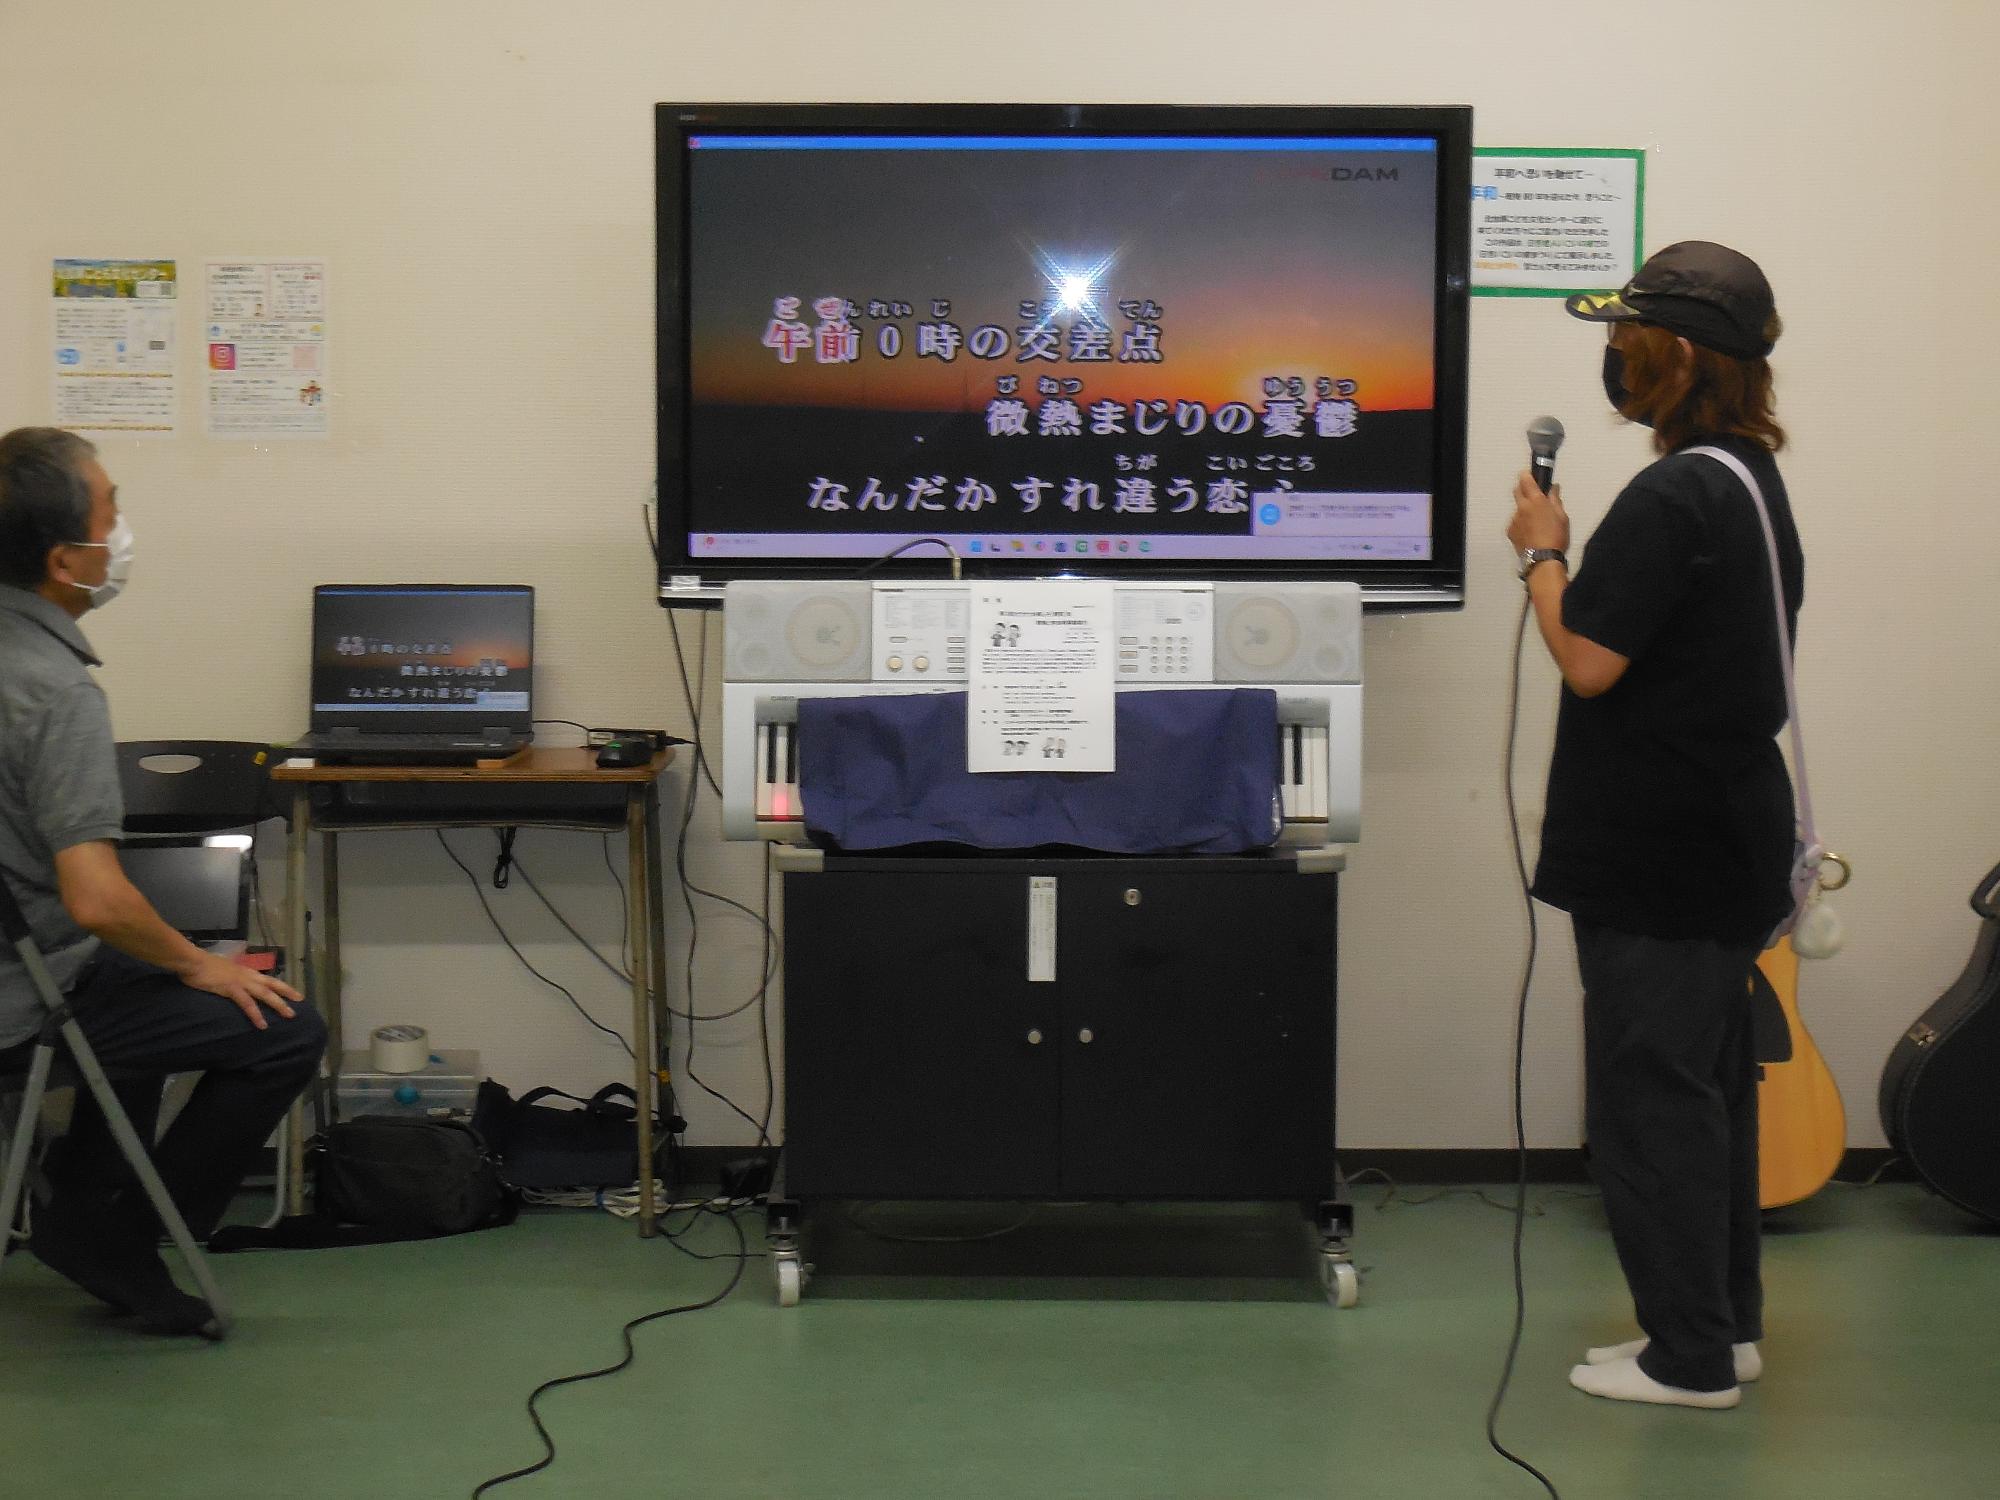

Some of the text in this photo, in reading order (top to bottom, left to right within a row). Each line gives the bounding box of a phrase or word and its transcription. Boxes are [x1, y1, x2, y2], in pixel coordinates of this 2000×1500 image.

[1331, 166, 1399, 182] DAM
[986, 398, 1359, 438] 微熱まじりの憂鬱
